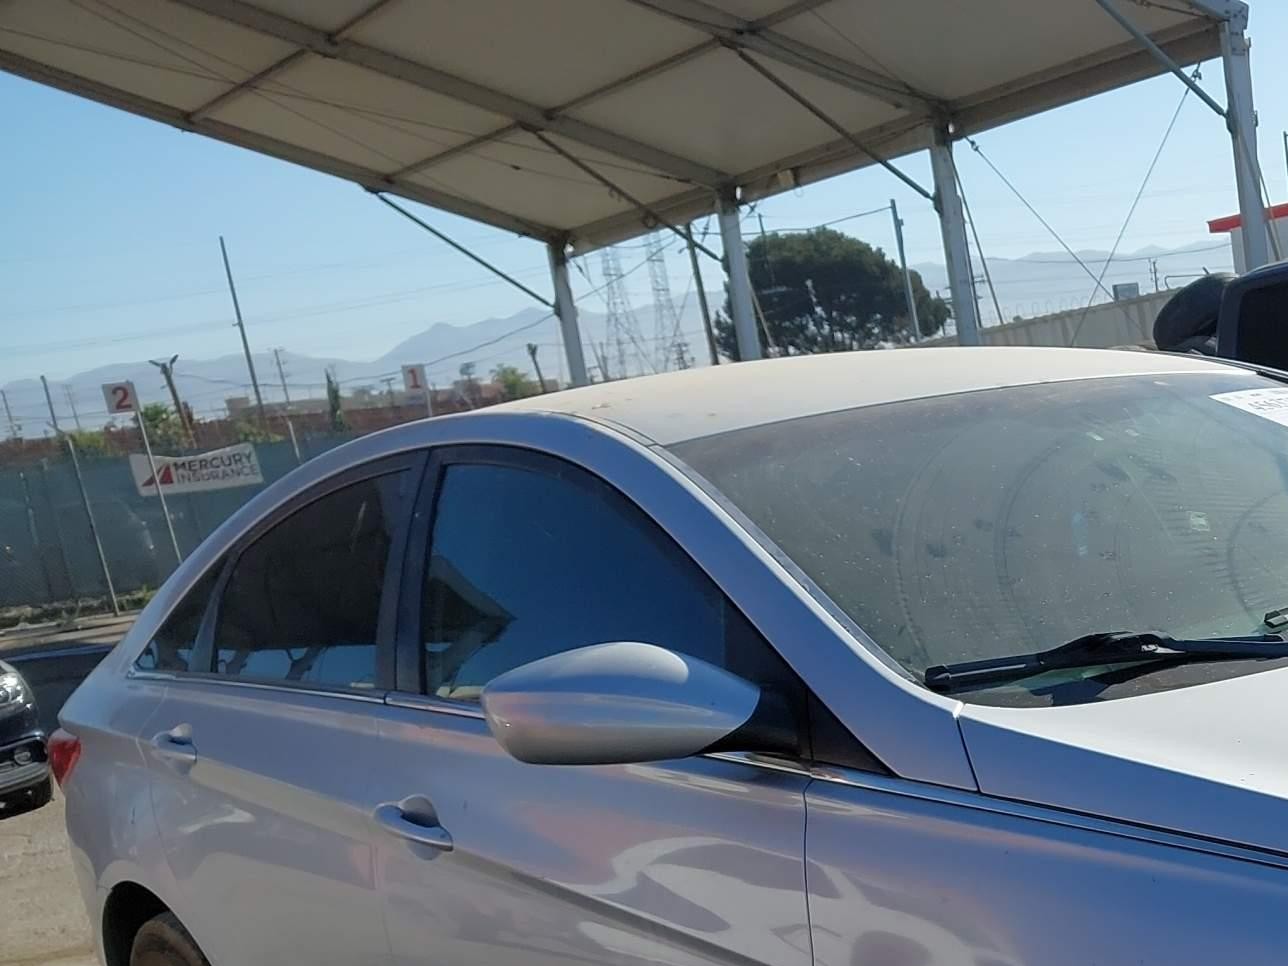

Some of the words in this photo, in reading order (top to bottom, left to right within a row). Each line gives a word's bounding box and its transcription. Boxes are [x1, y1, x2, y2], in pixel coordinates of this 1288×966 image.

[407, 367, 421, 389] 1
[112, 386, 132, 410] 2
[173, 451, 252, 473] MERCURY
[177, 463, 257, 484] INSURANCE
